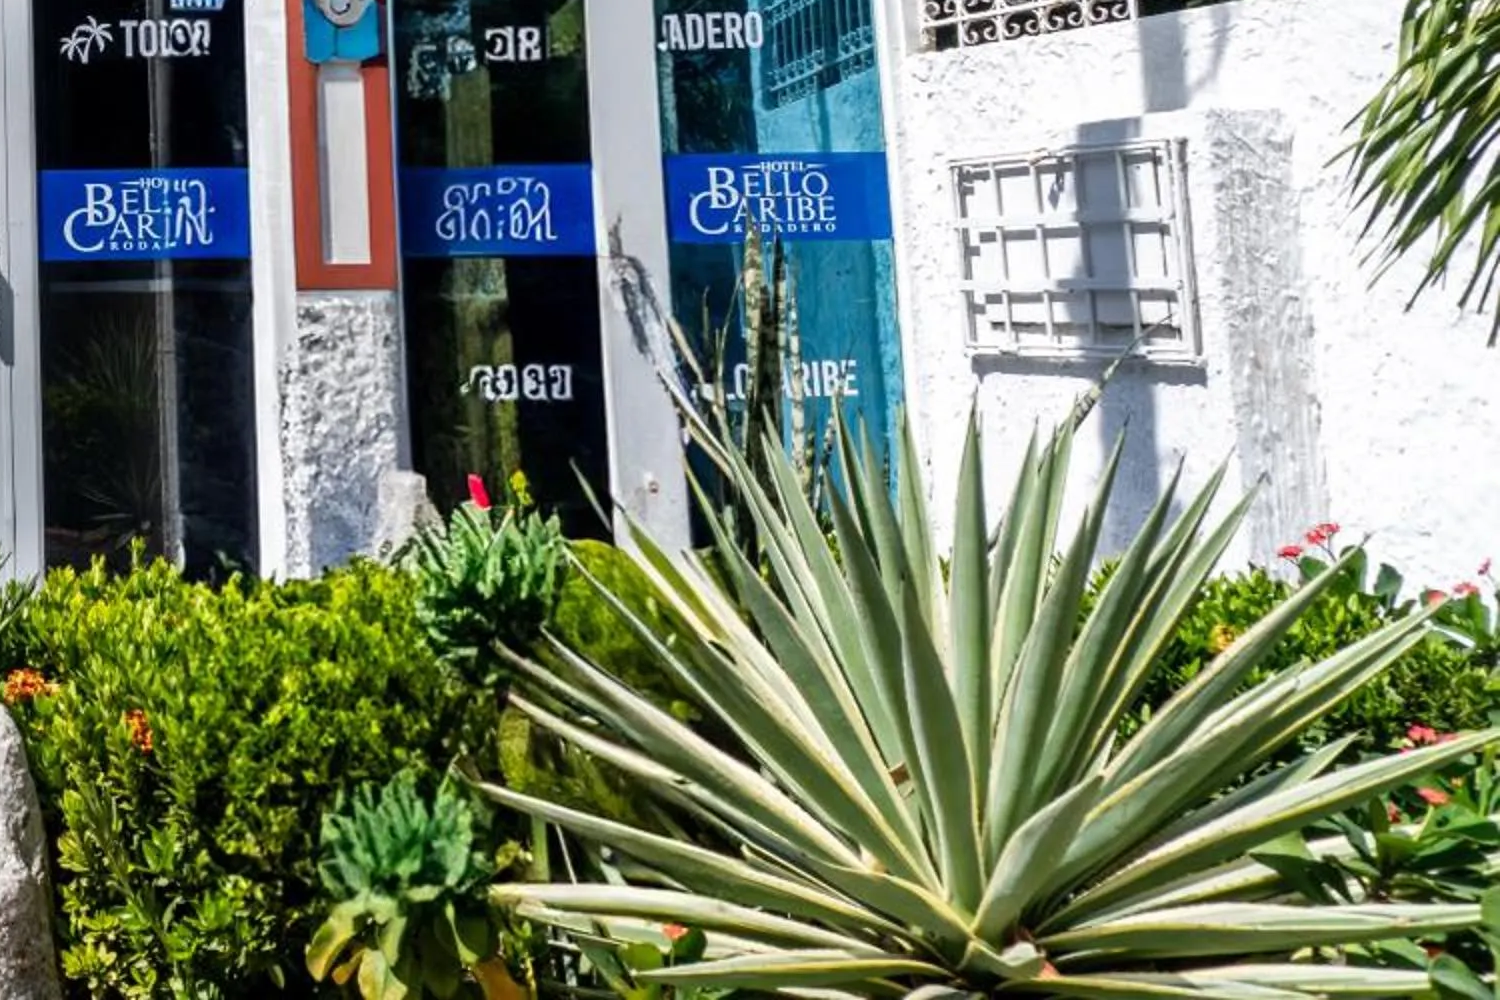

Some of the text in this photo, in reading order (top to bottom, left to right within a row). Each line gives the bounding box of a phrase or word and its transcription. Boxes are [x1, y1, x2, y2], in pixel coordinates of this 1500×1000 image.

[708, 167, 829, 208] BELLO
[690, 191, 836, 235] CARIBE
[733, 221, 837, 233] RDADERO
